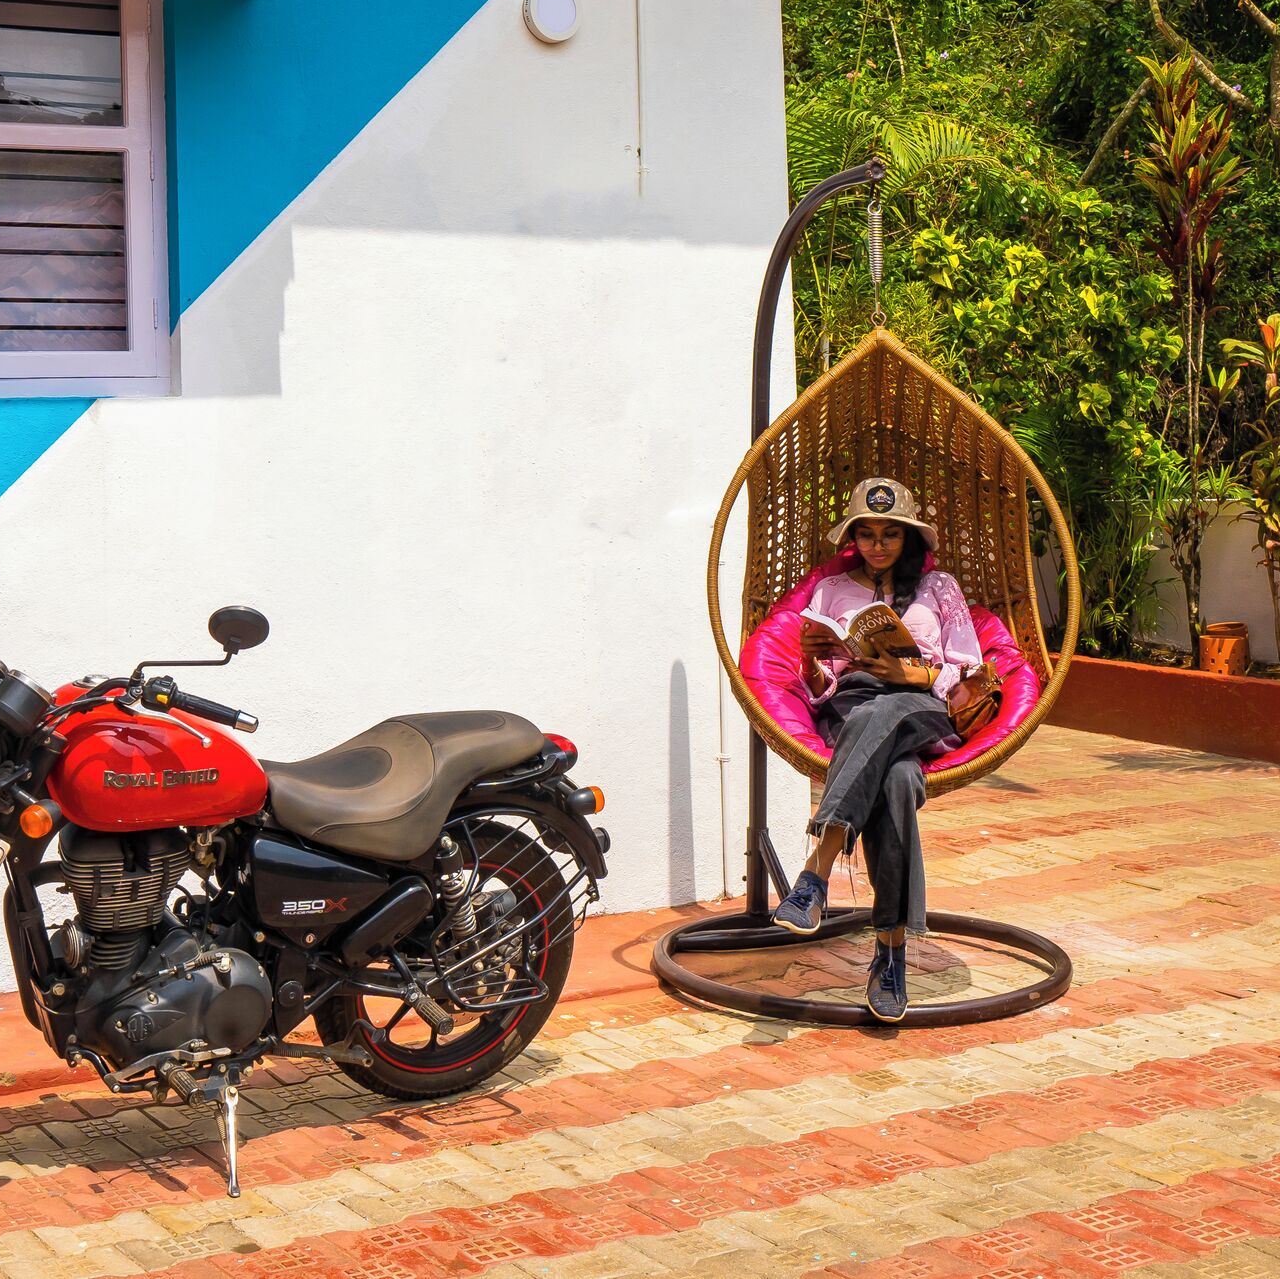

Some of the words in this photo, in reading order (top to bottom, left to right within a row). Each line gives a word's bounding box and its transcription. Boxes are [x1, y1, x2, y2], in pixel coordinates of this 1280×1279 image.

[858, 610, 881, 626] DAN
[854, 614, 899, 642] BROWN
[104, 770, 158, 789] ROYAL
[162, 767, 219, 789] ENFIELD
[282, 897, 349, 912] 350X
